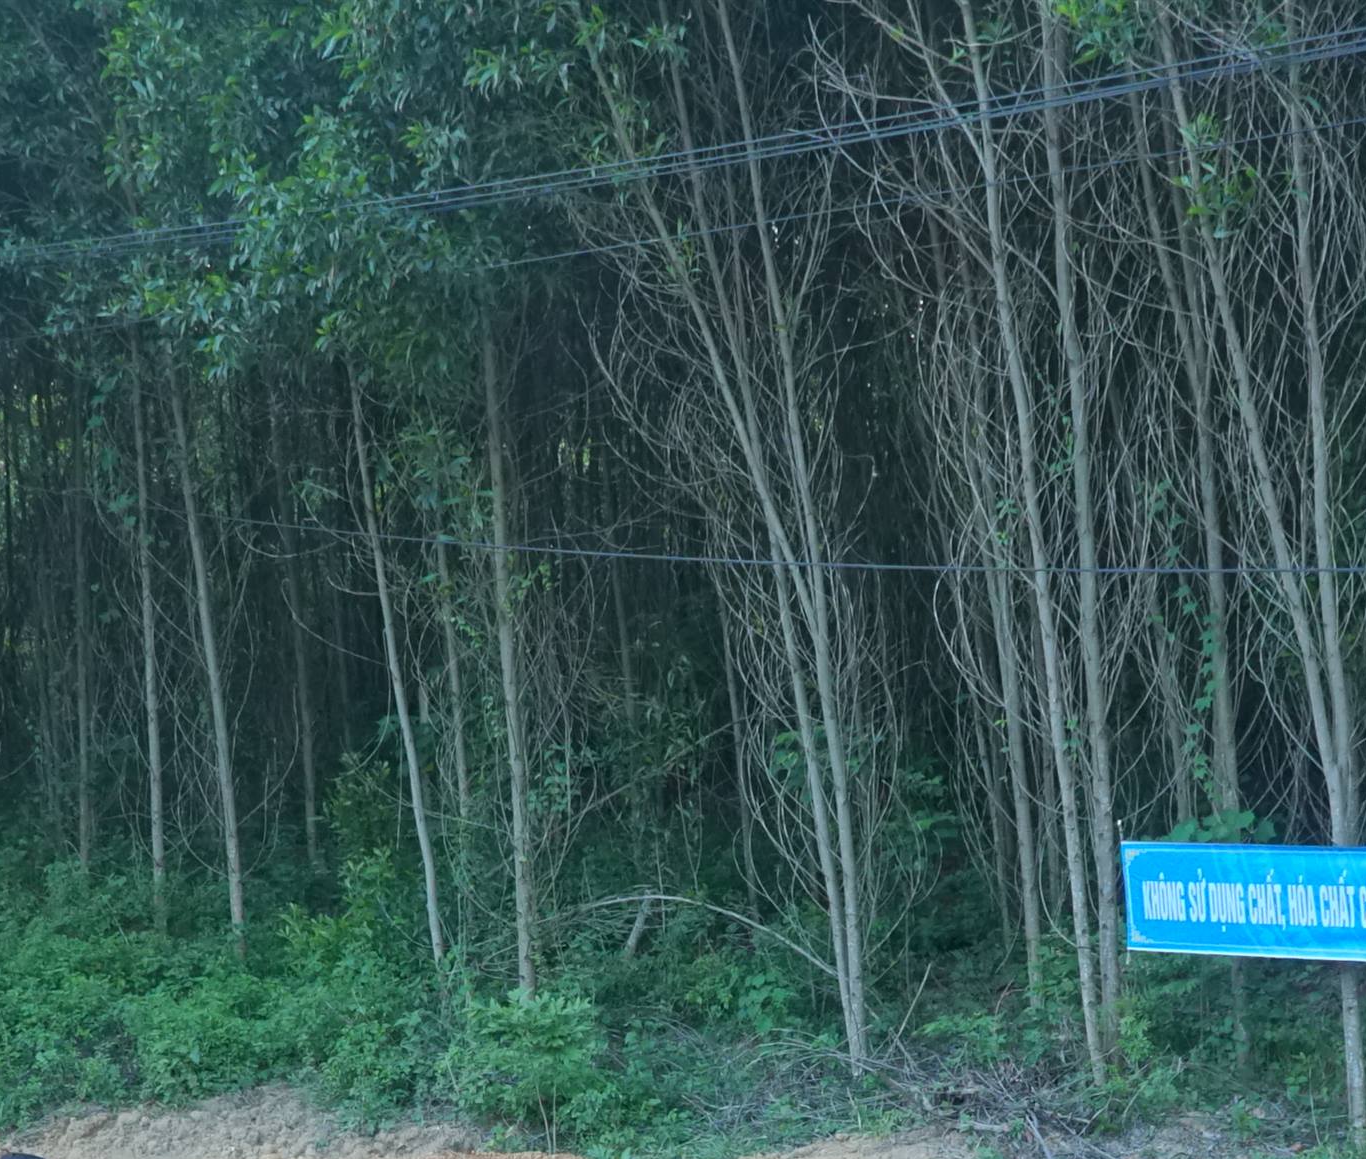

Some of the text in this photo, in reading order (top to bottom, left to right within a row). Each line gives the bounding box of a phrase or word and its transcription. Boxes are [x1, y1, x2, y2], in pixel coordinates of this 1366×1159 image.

[1142, 872, 1186, 922] KHÔNG
[1188, 868, 1207, 923] SỬ
[1208, 882, 1246, 932] DỤNG
[1248, 869, 1286, 930] CHẤT,
[1287, 875, 1318, 927] HÓA
[1319, 869, 1356, 928] CHẤT
